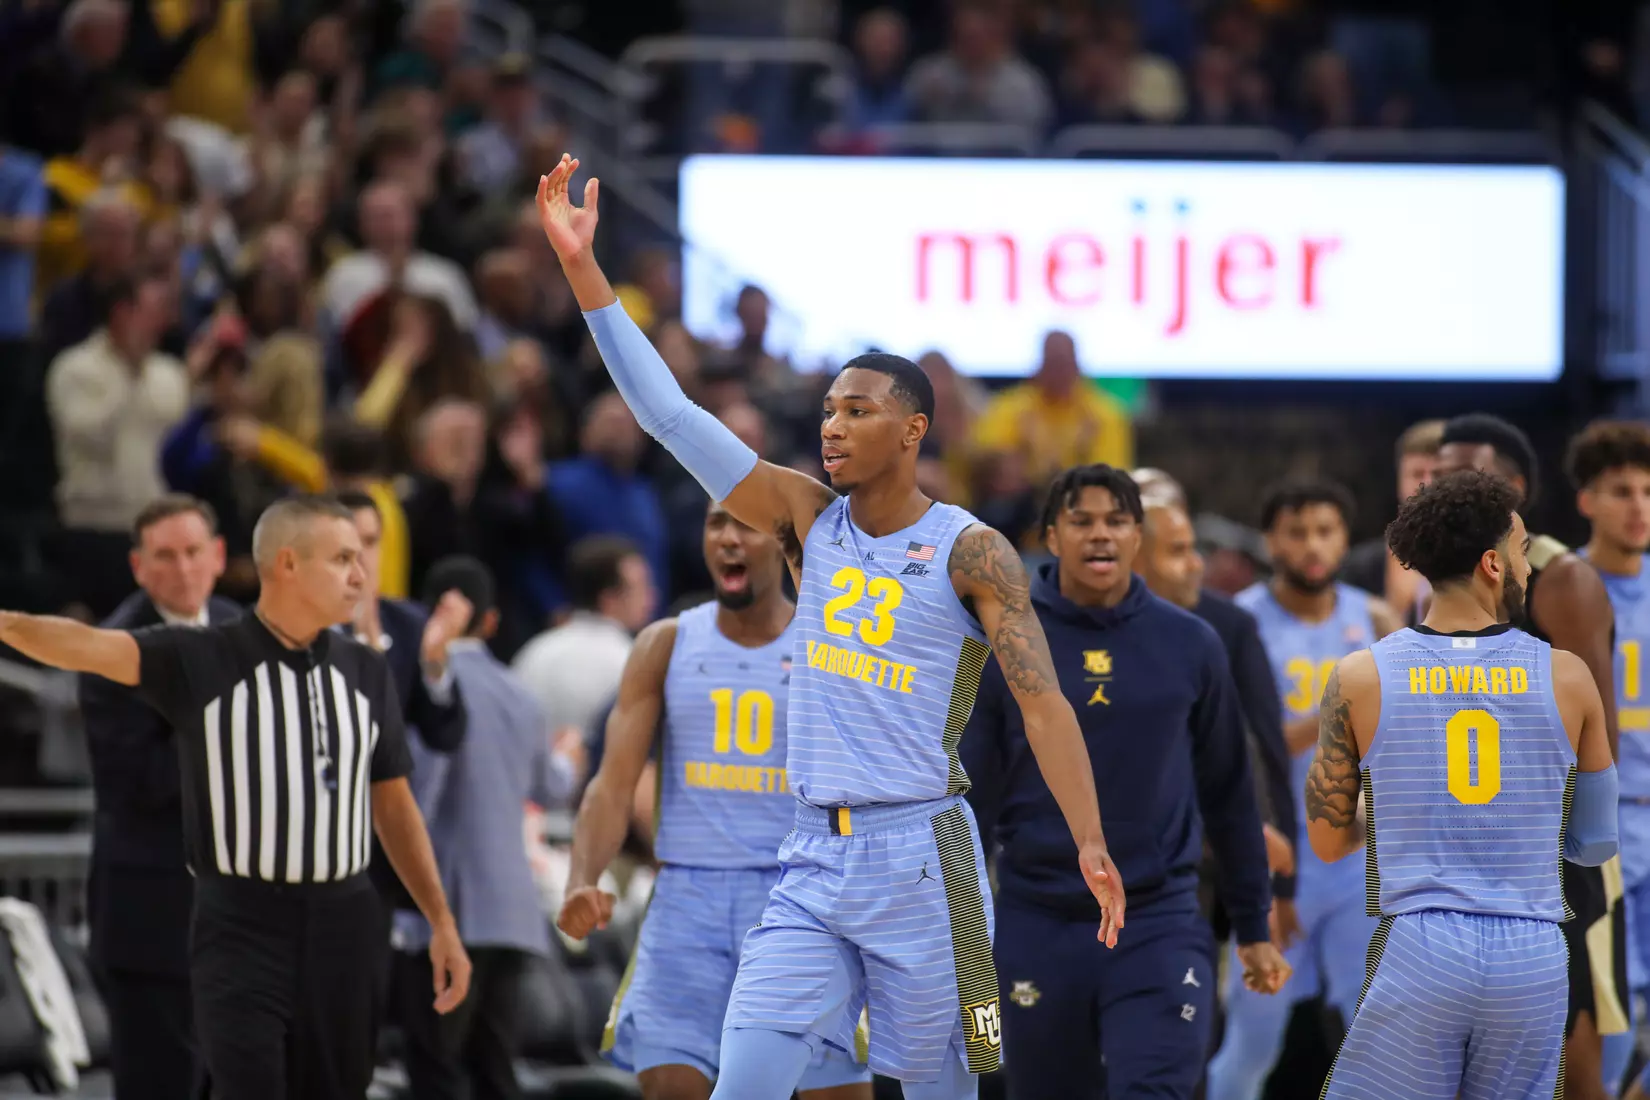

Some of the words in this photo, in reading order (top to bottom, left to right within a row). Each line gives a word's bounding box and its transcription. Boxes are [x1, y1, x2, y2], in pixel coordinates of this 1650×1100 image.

[914, 197, 1342, 338] meijer
[901, 567, 930, 578] EAST
[907, 562, 926, 570] BIG
[824, 566, 904, 647] 23
[1409, 665, 1529, 695] HOWARD
[710, 688, 774, 756] 10
[1446, 710, 1501, 805] 0
[970, 1000, 1001, 1048] MU
